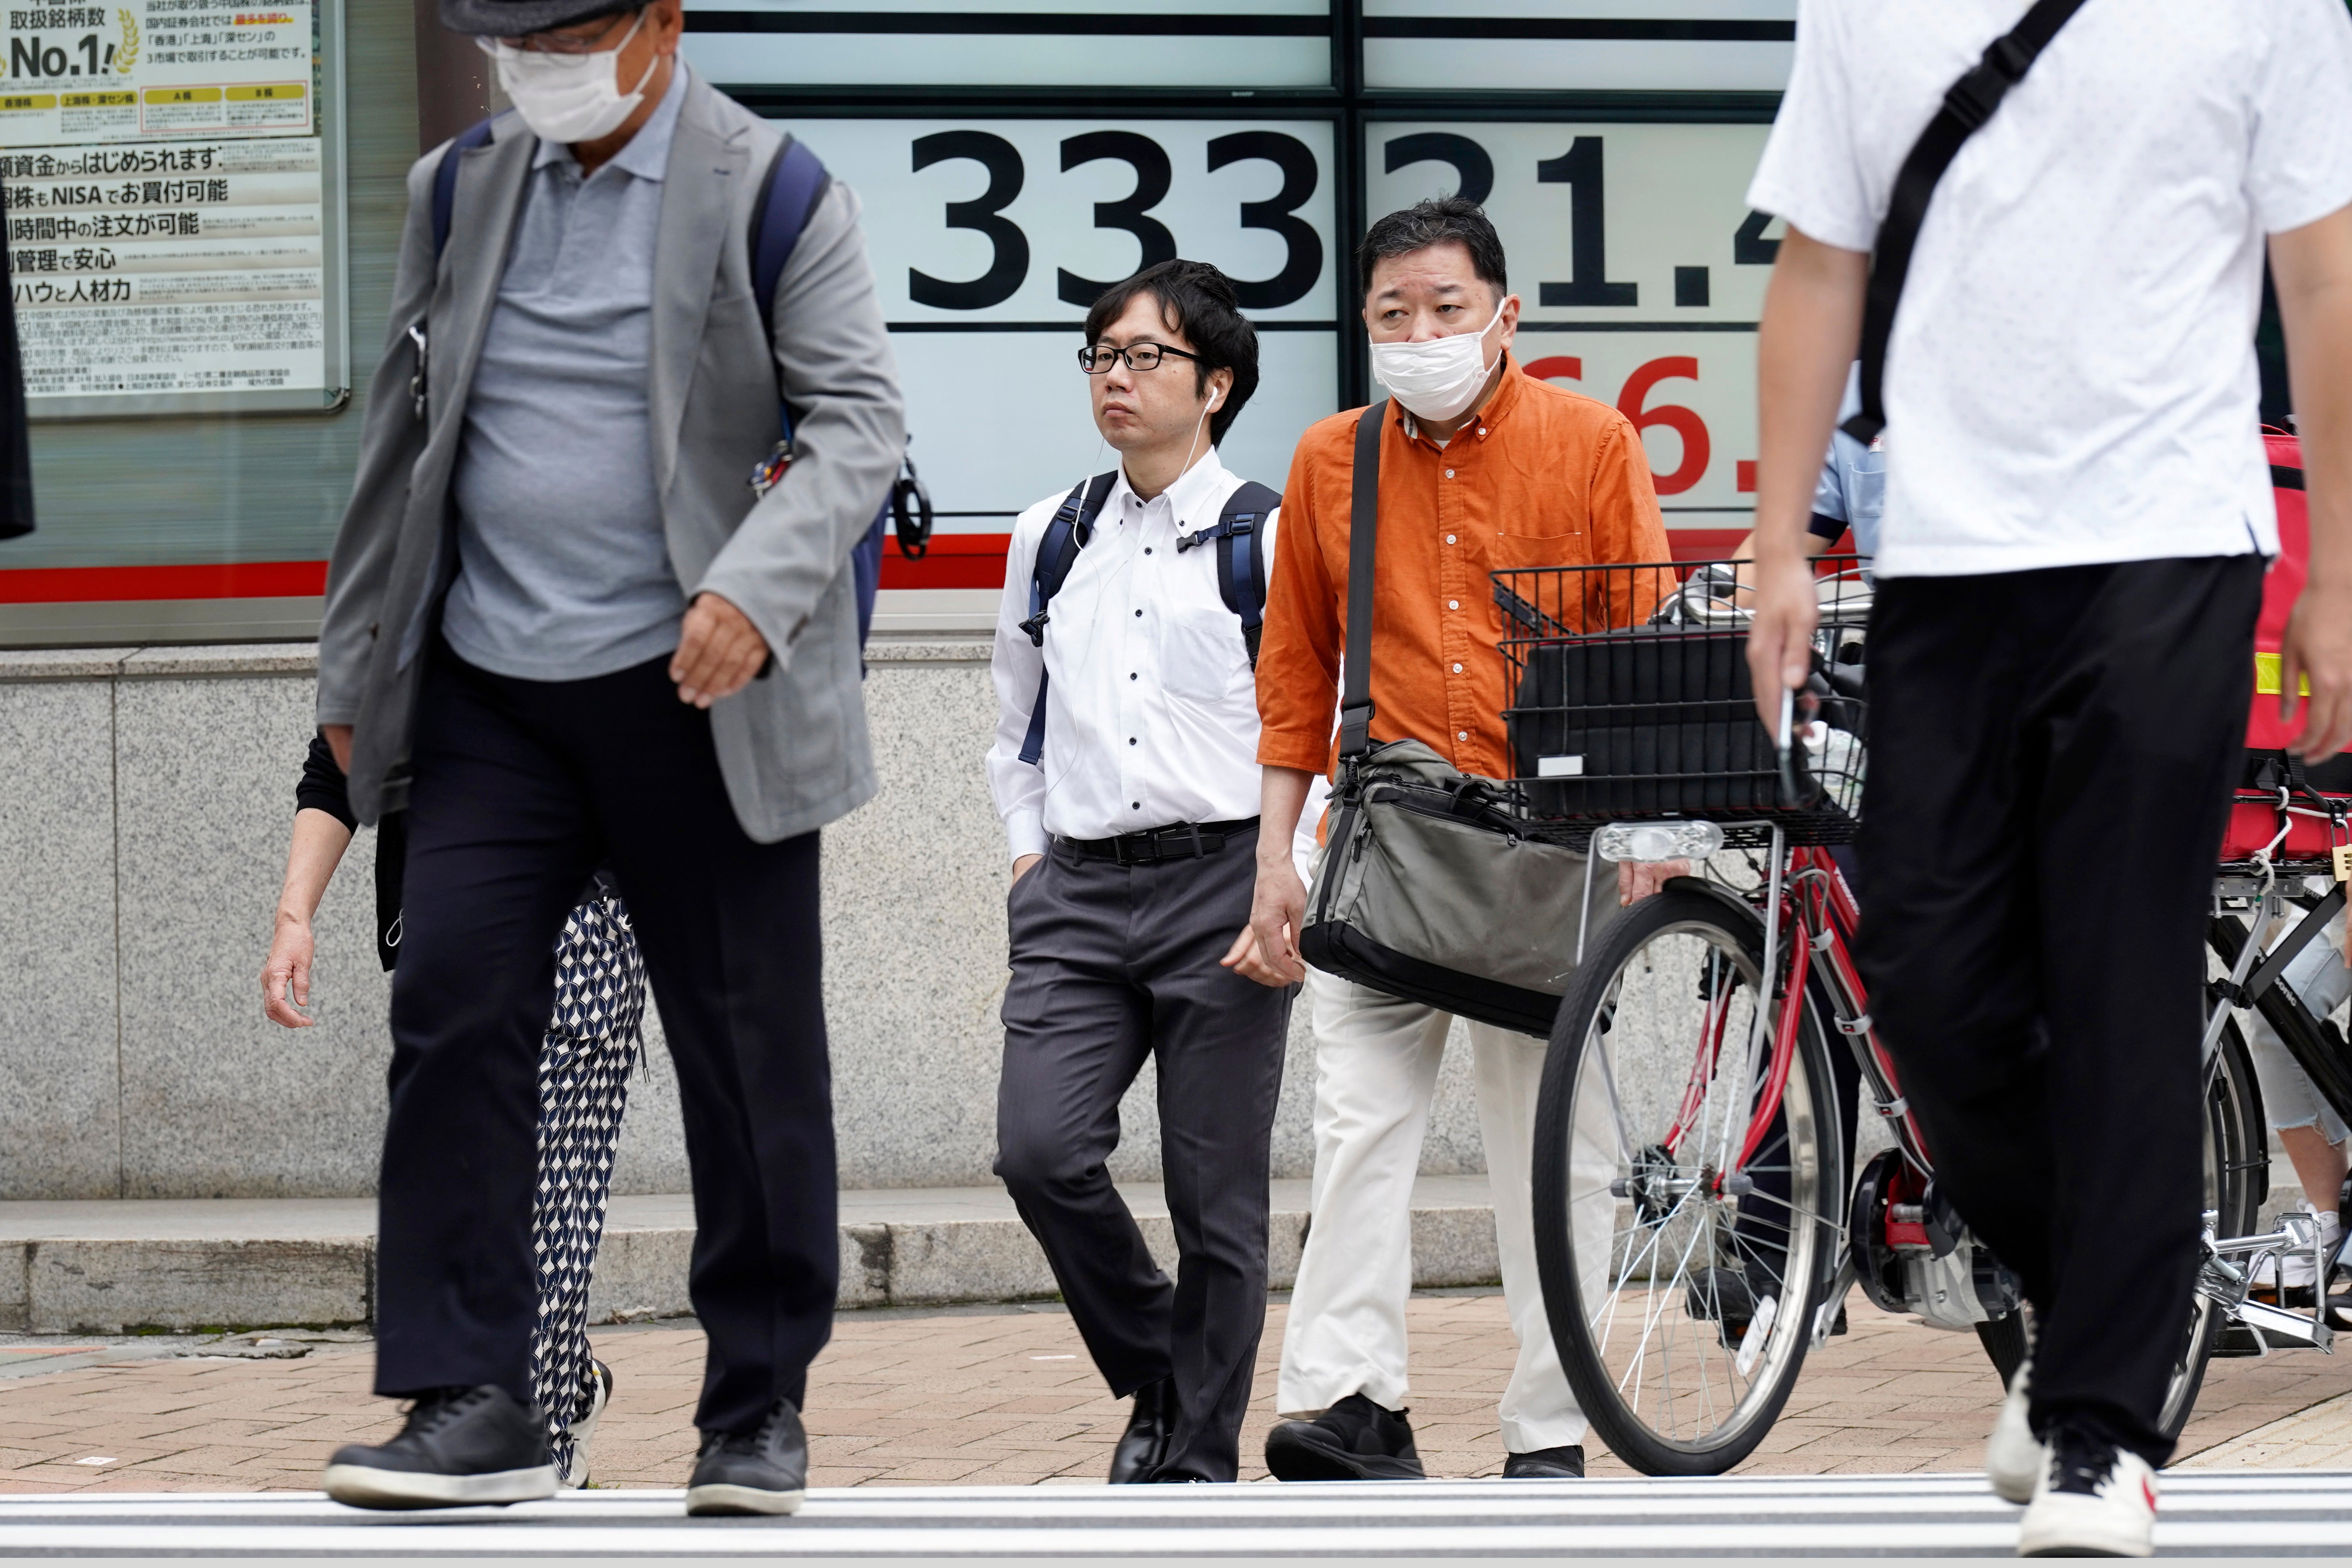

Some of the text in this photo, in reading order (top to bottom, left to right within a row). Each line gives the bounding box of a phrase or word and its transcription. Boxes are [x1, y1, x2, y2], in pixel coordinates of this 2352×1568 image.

[9, 7, 106, 30] 取扱銘柄数
[11, 34, 115, 78] No.1!
[10, 213, 199, 240] 時間中の注文が可能
